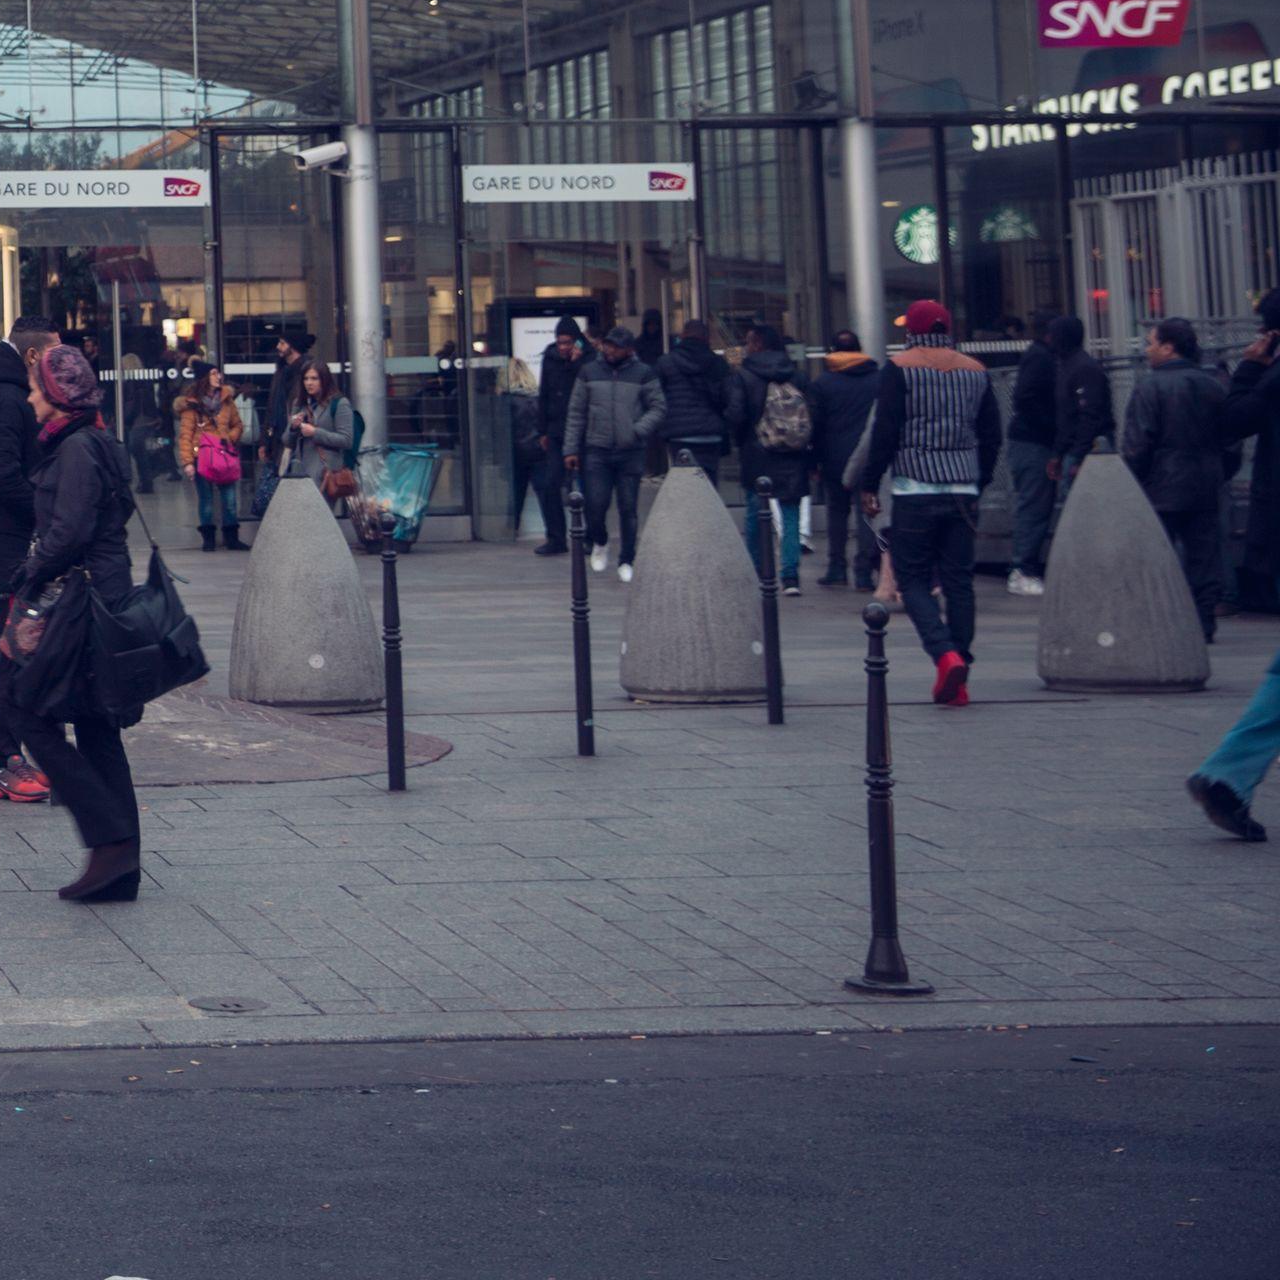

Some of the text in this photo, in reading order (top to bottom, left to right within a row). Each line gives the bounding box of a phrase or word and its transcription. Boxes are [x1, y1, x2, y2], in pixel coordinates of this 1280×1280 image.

[45, 182, 69, 196] DU
[77, 181, 130, 195] NORD
[472, 175, 615, 191] GARE DU NORD
[649, 177, 684, 189] SNCF
[165, 185, 199, 196] SNCF
